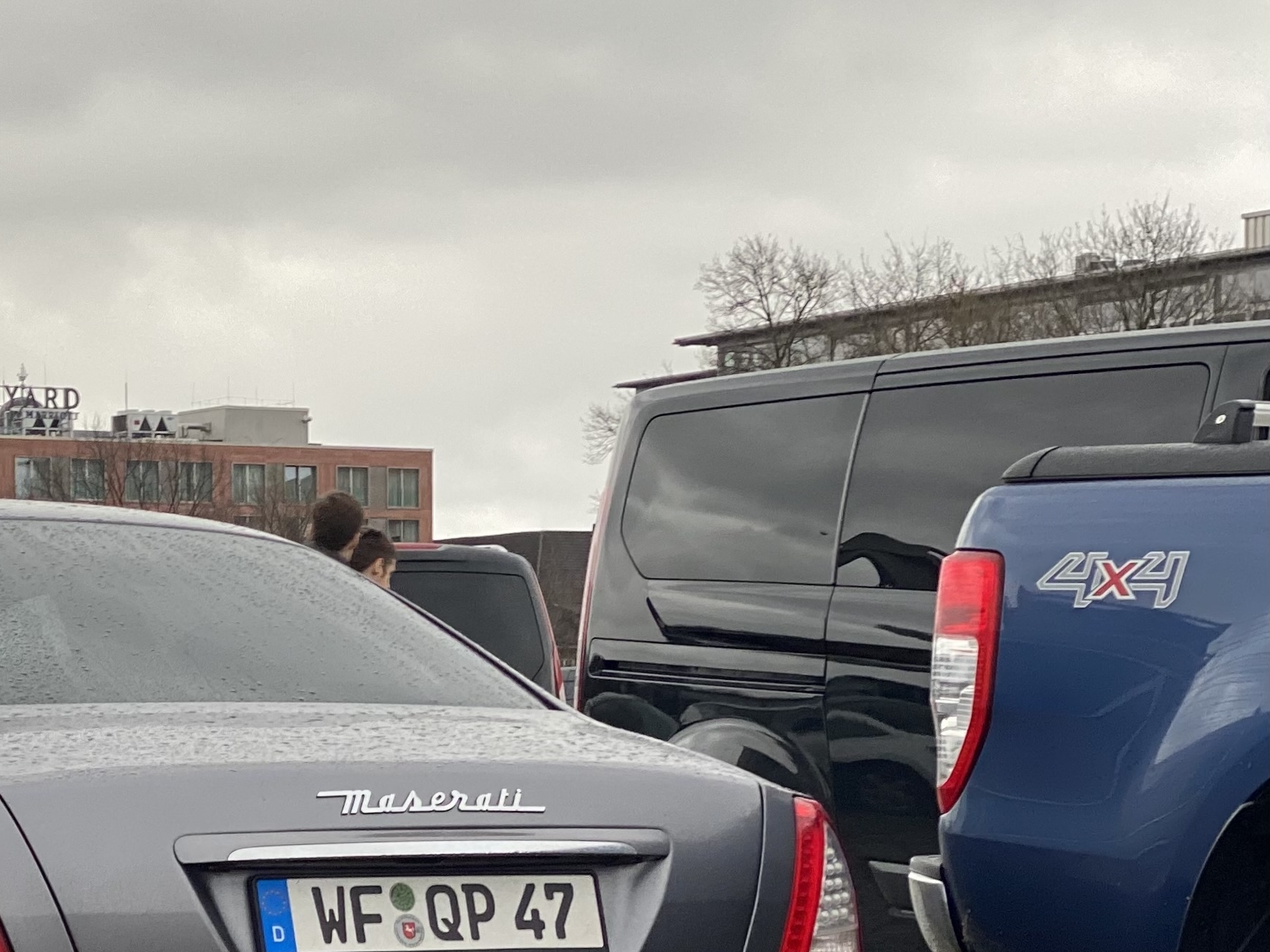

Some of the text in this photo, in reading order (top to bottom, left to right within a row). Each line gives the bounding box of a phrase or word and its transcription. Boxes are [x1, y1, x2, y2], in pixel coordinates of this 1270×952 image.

[316, 788, 546, 815] Maserati
[272, 925, 285, 943] D
[311, 885, 383, 944] WF
[425, 884, 495, 941] QP
[515, 883, 574, 940] 47
